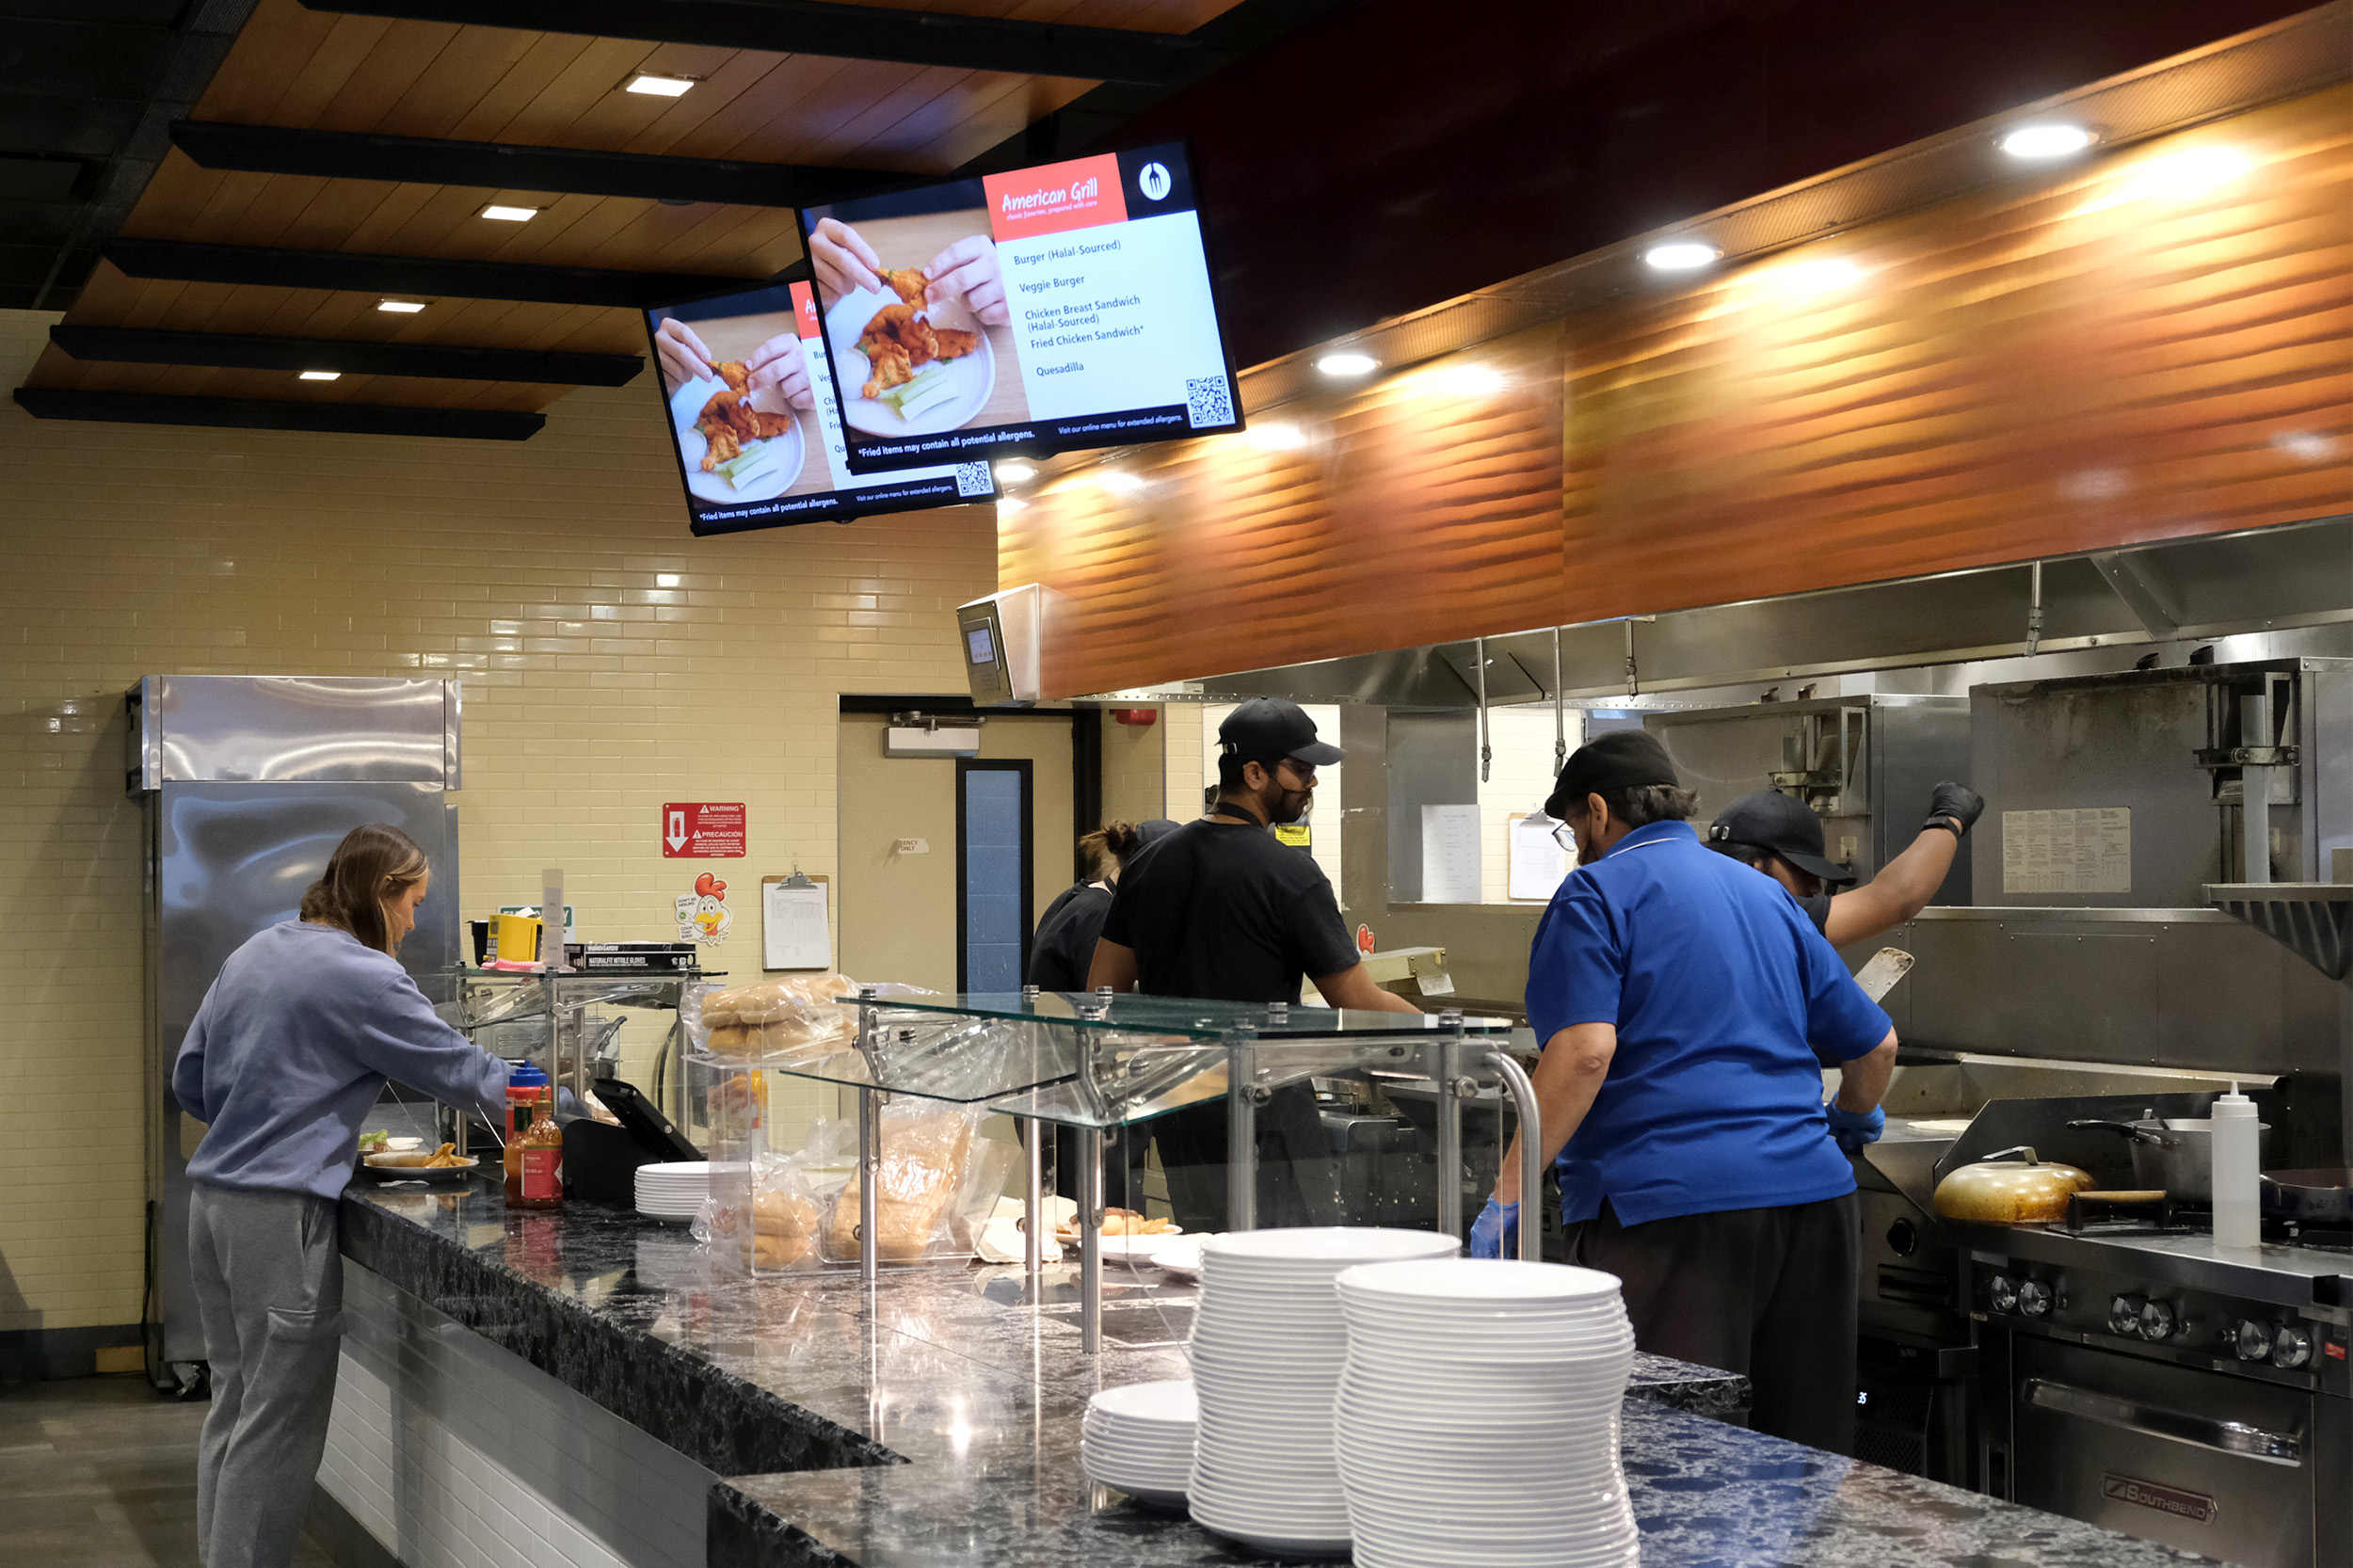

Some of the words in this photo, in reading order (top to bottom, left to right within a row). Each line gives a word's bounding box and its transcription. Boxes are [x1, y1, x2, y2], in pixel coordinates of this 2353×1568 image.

[1001, 188, 1066, 213] American
[1071, 177, 1098, 201] Grill
[1048, 203, 1073, 215] prepared
[1073, 200, 1085, 209] with
[1014, 252, 1046, 266] Burger
[1048, 239, 1122, 262] (Halal-Sourced)
[1019, 280, 1051, 294] Veggie
[1053, 275, 1085, 288] Burger
[1025, 307, 1062, 320] Chicken
[1064, 302, 1093, 315] Breast
[1095, 295, 1141, 311] Sandwich
[1027, 313, 1100, 333] (Halal-Sourced)
[1031, 337, 1054, 349] Fried
[1056, 333, 1093, 345] Chicken
[1036, 361, 1084, 377] Quesadilla
[1058, 426, 1071, 435] Visit
[1082, 424, 1099, 432] online
[1127, 416, 1154, 426] extended
[1155, 414, 1183, 424] allergens.
[882, 444, 904, 455] items
[904, 443, 920, 454] may
[921, 439, 950, 451] contain
[951, 437, 960, 447] all
[961, 433, 996, 447] potential
[998, 430, 1035, 442] allergens.
[735, 509, 748, 519] may
[749, 505, 772, 515] contain
[772, 504, 780, 512] all
[780, 500, 808, 513] potential
[808, 498, 839, 508] allergens.
[2126, 1484, 2206, 1518] SOUTHBEND
